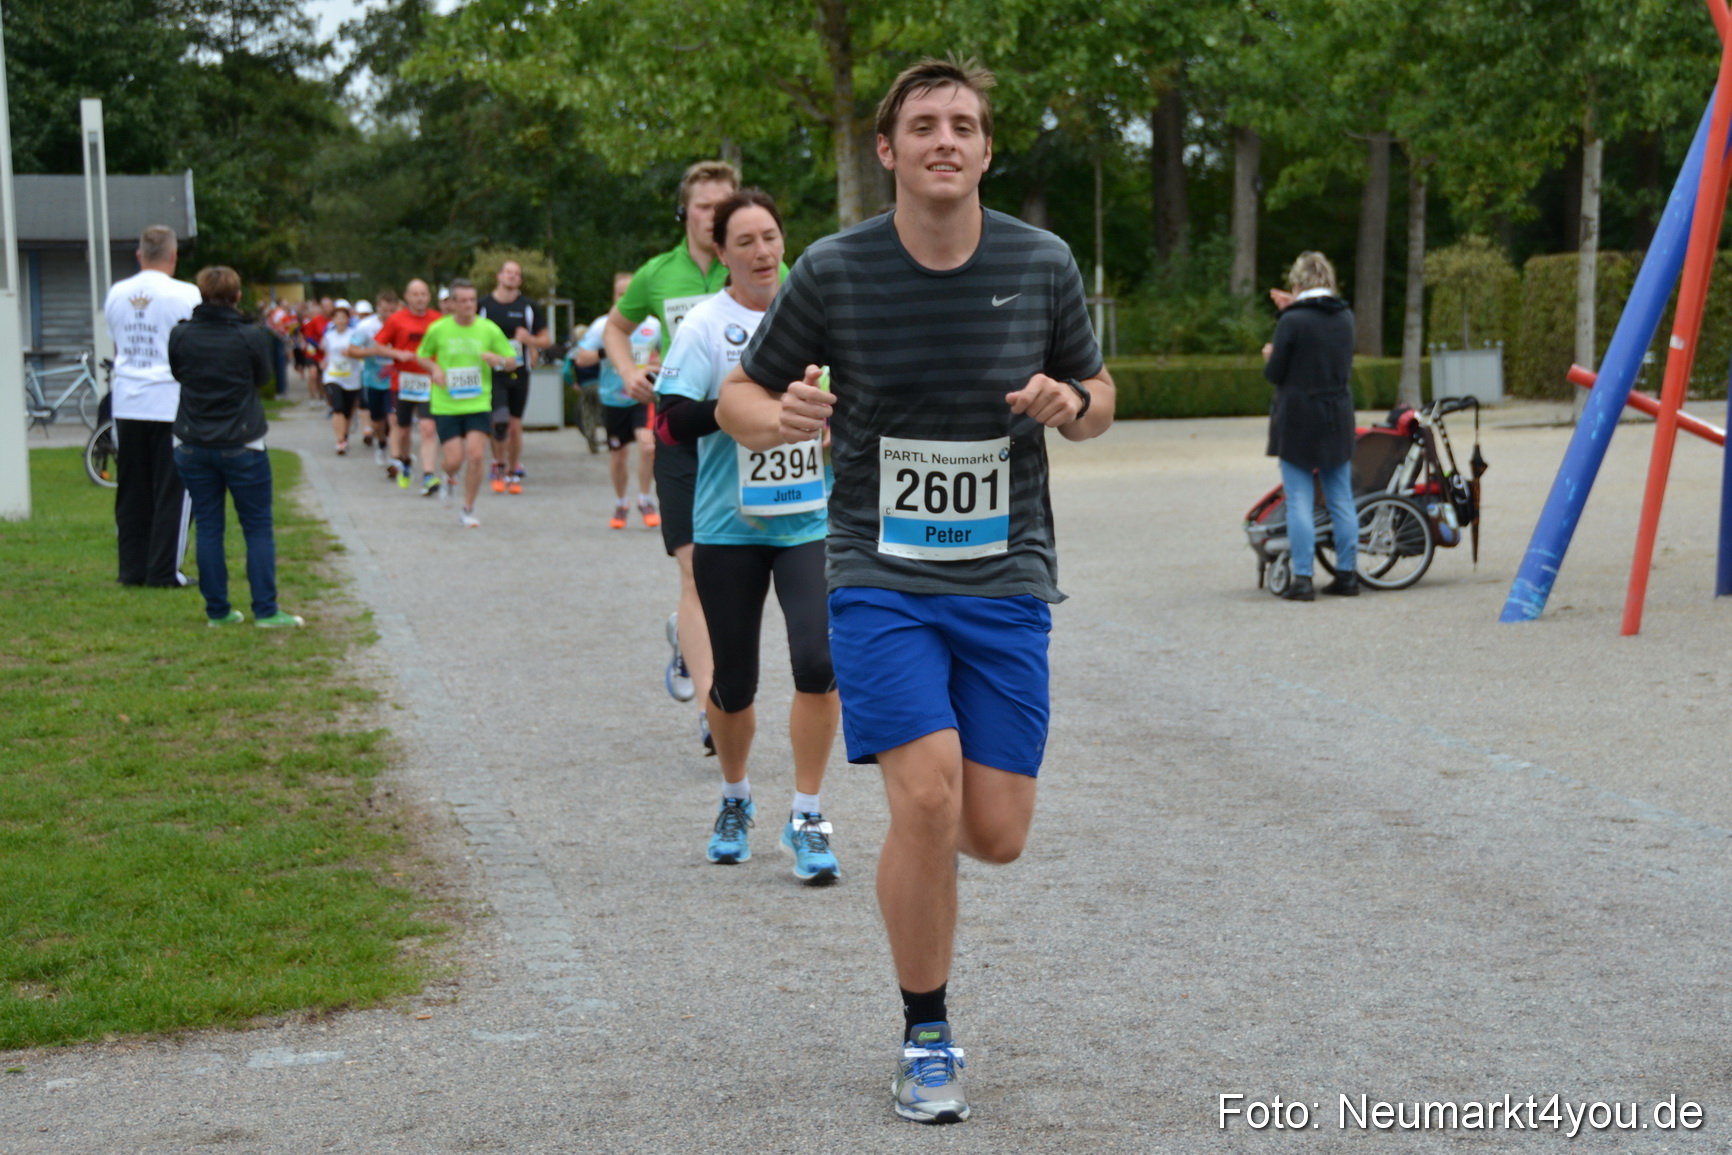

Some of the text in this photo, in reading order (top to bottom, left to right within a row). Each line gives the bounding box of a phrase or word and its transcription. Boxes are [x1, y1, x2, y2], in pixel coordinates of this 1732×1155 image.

[749, 446, 818, 481] 2394
[884, 449, 994, 465] PARTL Neumarkt
[773, 488, 802, 503] Jutta
[895, 467, 999, 514] 2601
[925, 525, 972, 543] Peter
